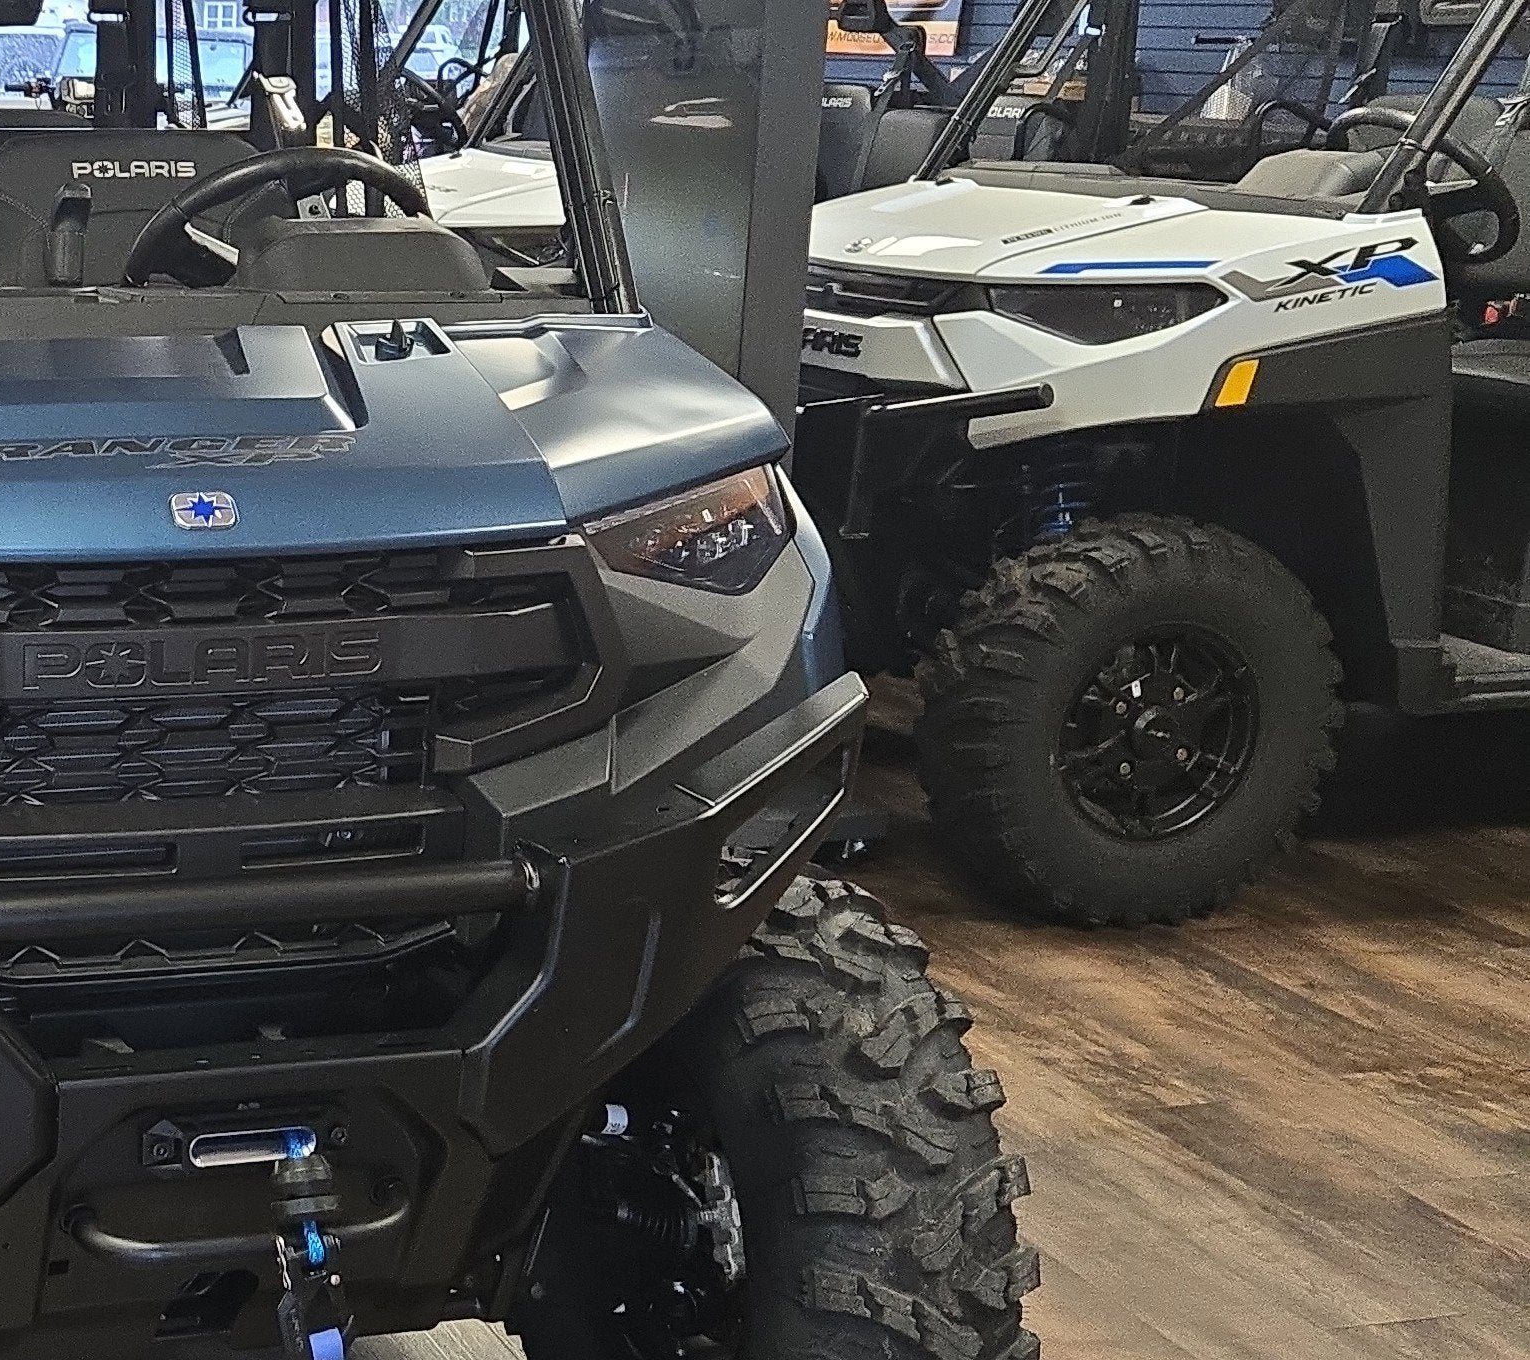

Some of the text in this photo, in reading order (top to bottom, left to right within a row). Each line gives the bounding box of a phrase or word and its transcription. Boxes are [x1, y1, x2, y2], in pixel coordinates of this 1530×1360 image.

[72, 159, 197, 180] POLARIS
[1268, 237, 1420, 289] XP
[1274, 282, 1377, 313] KINETIC
[146, 450, 325, 470] XP
[22, 631, 383, 691] POLARIS
